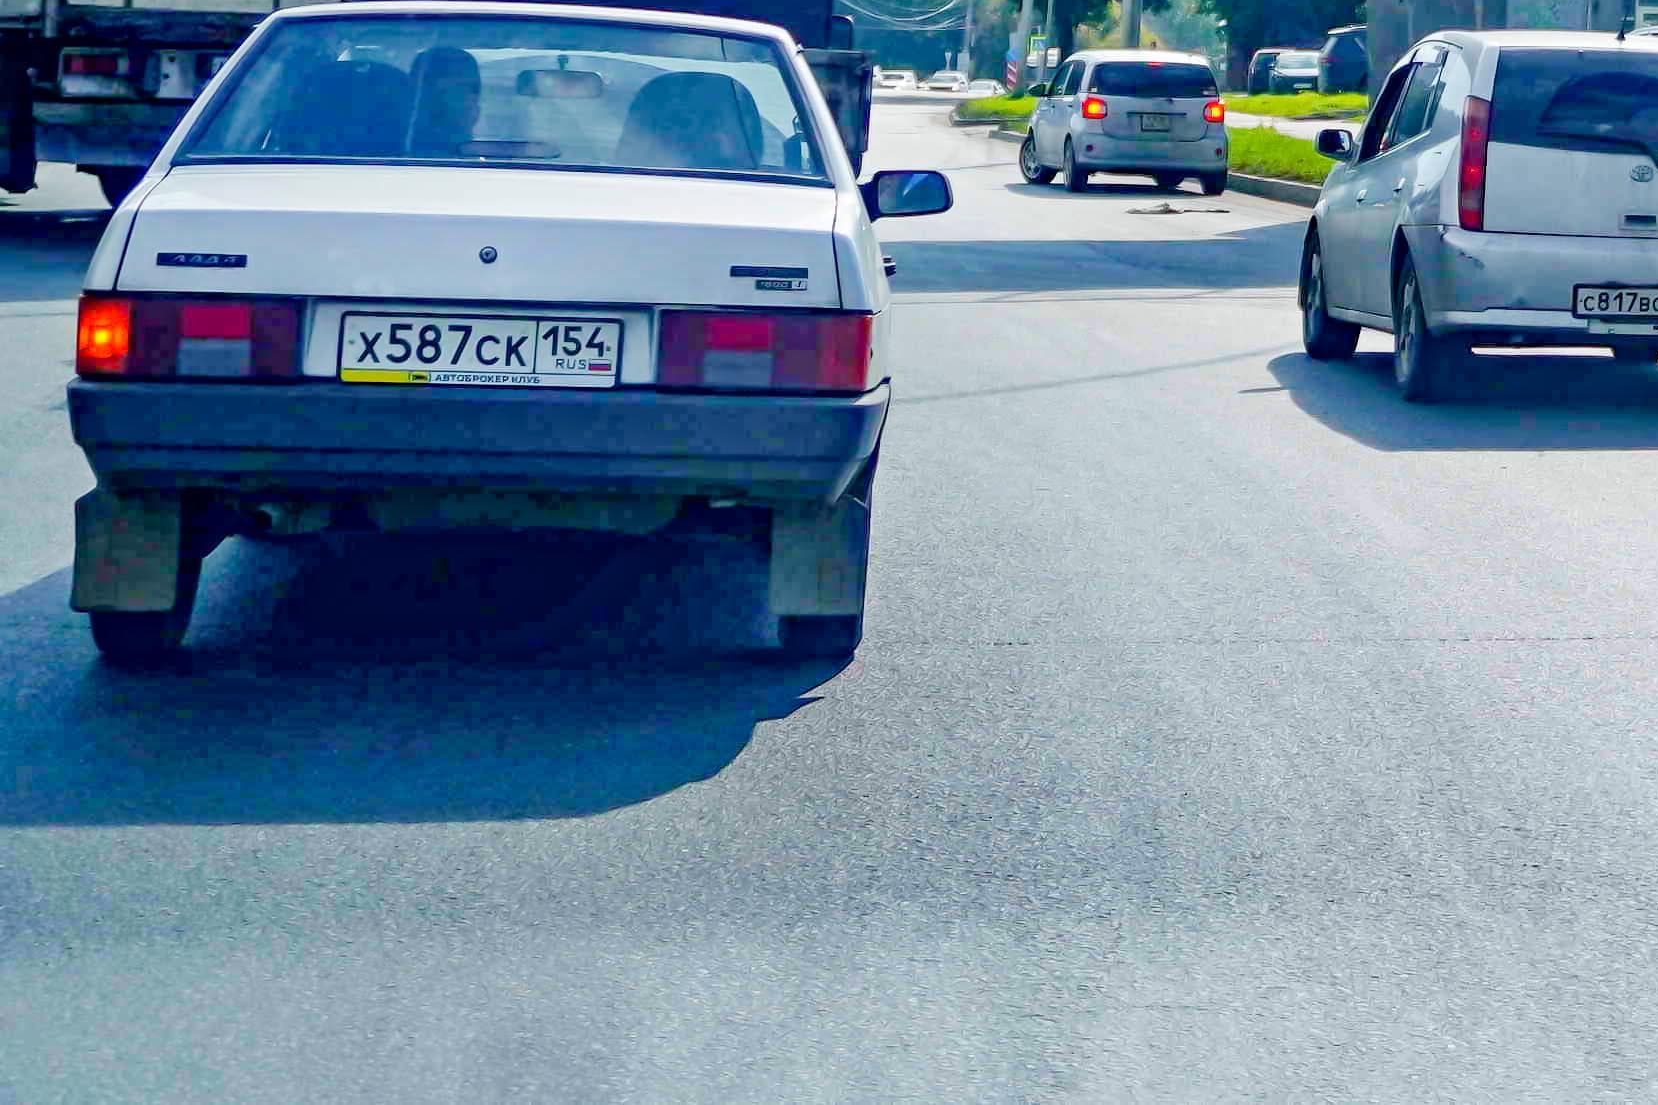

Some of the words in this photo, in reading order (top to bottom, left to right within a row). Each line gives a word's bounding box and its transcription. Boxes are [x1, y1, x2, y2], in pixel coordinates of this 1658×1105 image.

[356, 323, 530, 368] Х587СК
[542, 324, 606, 357] 154
[555, 357, 587, 370] RUS
